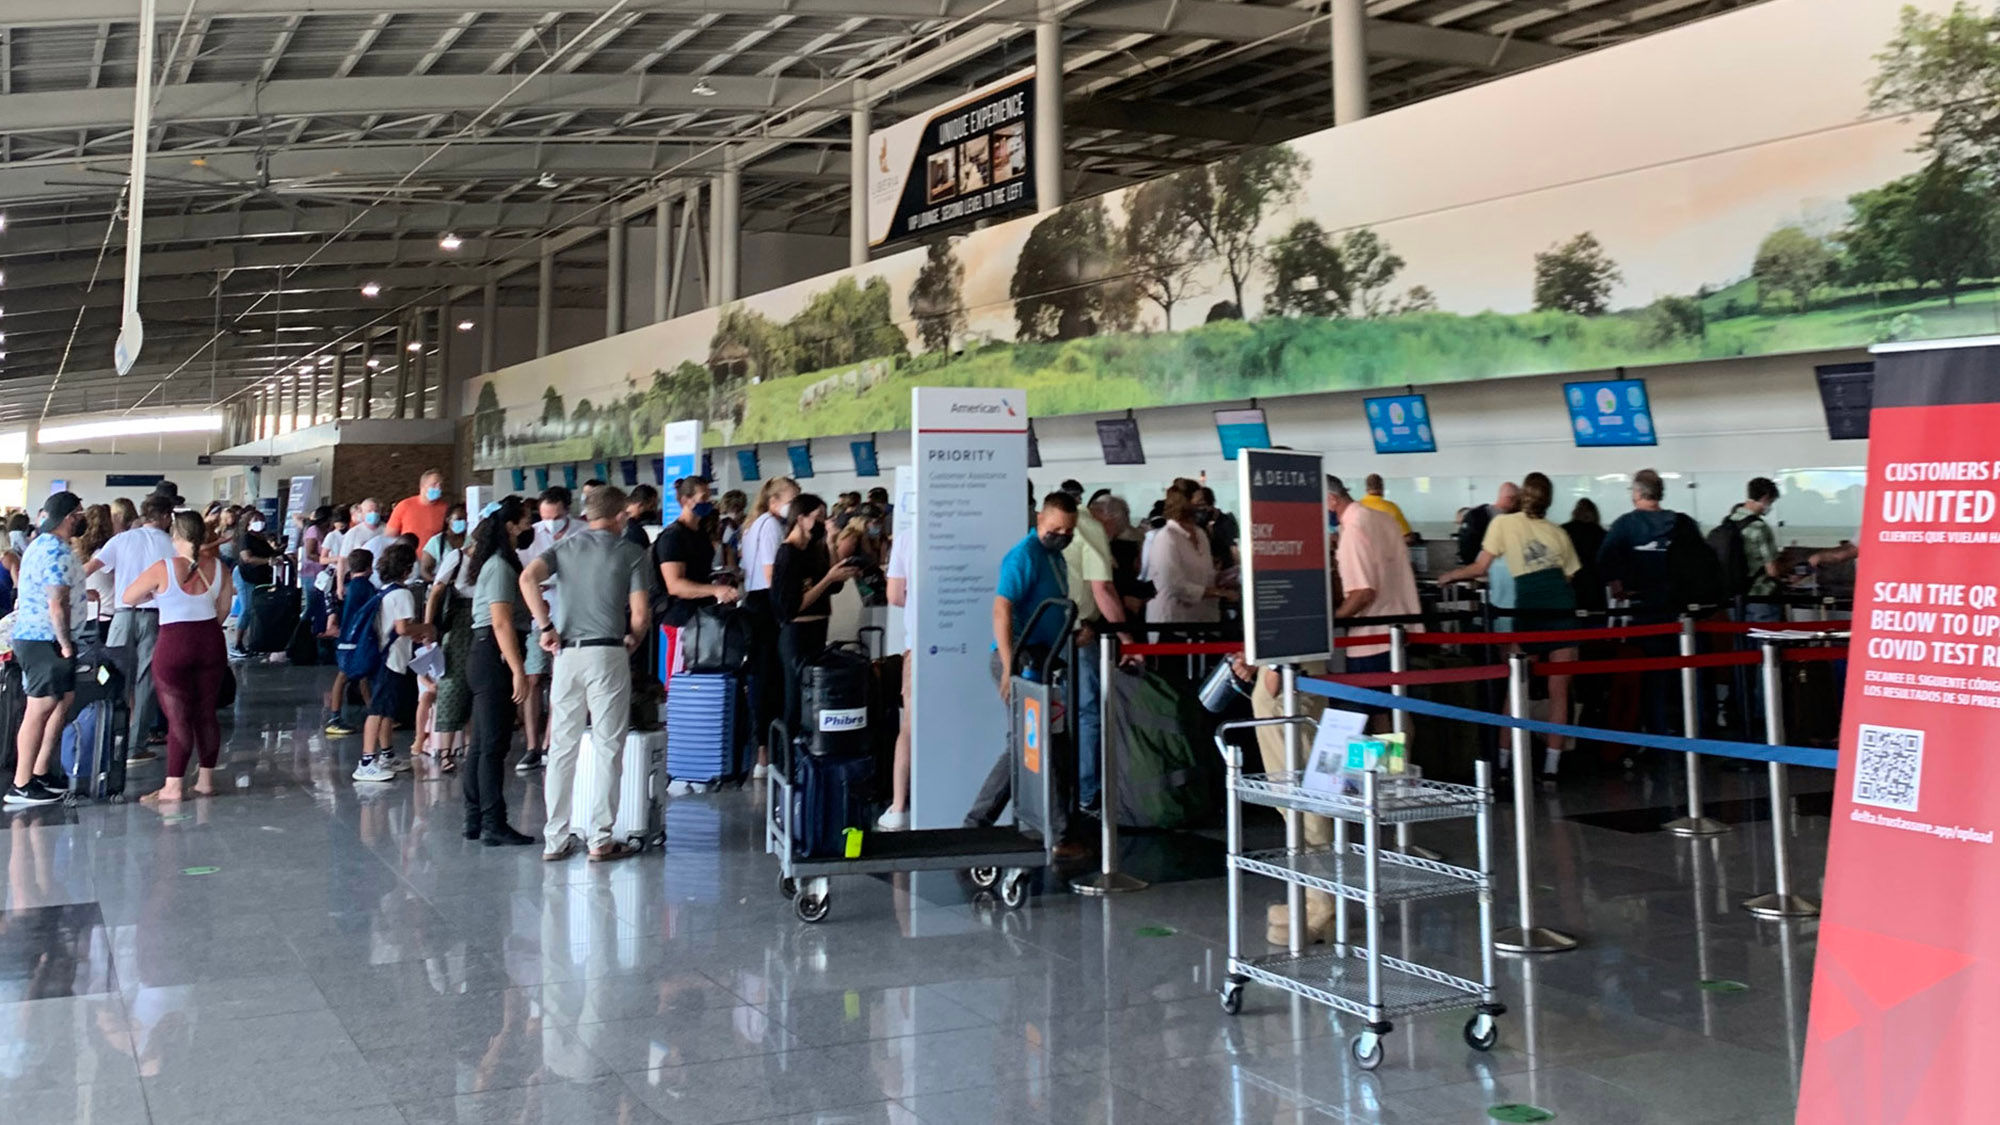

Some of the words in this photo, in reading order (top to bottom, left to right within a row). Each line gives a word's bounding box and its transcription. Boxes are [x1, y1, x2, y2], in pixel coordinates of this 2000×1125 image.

[939, 114, 969, 145] UNIQUE
[970, 91, 1024, 134] EXPERIENCE
[907, 214, 918, 231] VIP
[941, 200, 964, 221] SECOND
[964, 194, 983, 215] LEVEL
[984, 191, 993, 208] TO
[993, 187, 1005, 205] THE
[1006, 181, 1023, 201] LEFT
[951, 402, 1001, 414] American
[928, 449, 995, 461] PRIORITY
[928, 471, 967, 480] Customer
[968, 471, 1007, 480] Assistance
[1265, 470, 1307, 486] DELTA
[1884, 460, 1991, 481] CUSTOMERS
[1882, 489, 1996, 523] UNITED
[1252, 523, 1274, 539] SKY
[1879, 531, 1925, 542] CLIENTES
[1925, 531, 1947, 544] QUE
[1947, 532, 1988, 543] VUELAN
[1252, 540, 1304, 556] PRIORITY
[1872, 581, 1923, 604] SCAN
[1927, 583, 1966, 606] THE
[1968, 585, 1998, 610] QR
[1871, 609, 1937, 633] BELOW
[1941, 612, 1968, 636] TO
[1867, 637, 1927, 661] COVID
[1930, 641, 1979, 665] TEST
[1906, 672, 1917, 684] EL
[1917, 674, 1968, 689] SIGUIENTE
[1864, 684, 1883, 697] LOS
[1883, 686, 1942, 702] RESULTADOS
[1943, 691, 1957, 704] DE
[1957, 693, 1970, 705] SU
[824, 715, 865, 725] Phibro
